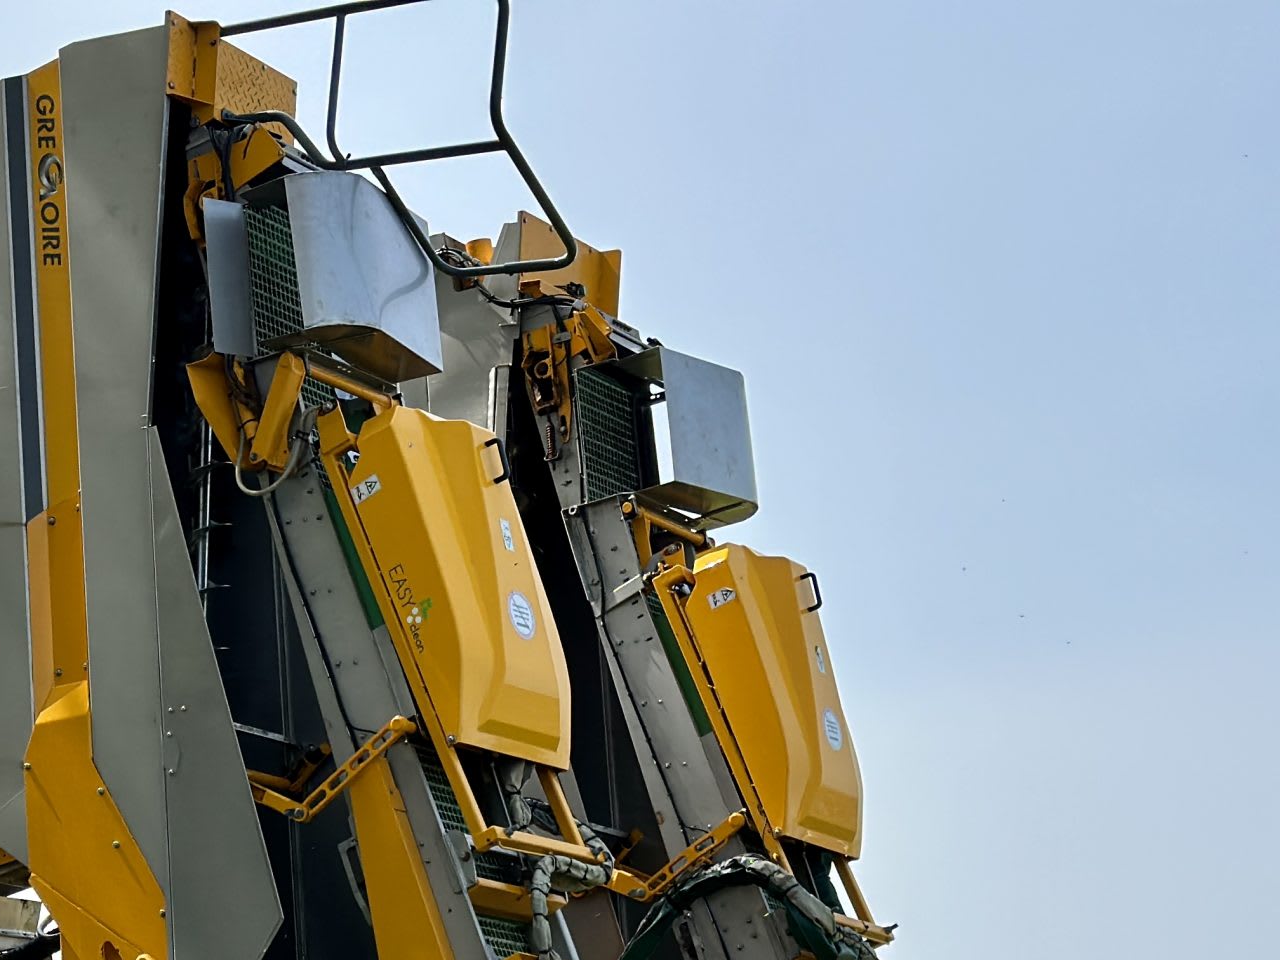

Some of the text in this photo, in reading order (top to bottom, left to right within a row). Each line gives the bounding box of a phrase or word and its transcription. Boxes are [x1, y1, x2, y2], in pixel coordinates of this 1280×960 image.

[35, 94, 63, 266] GREGOIRE
[388, 564, 424, 653] EASY clean
